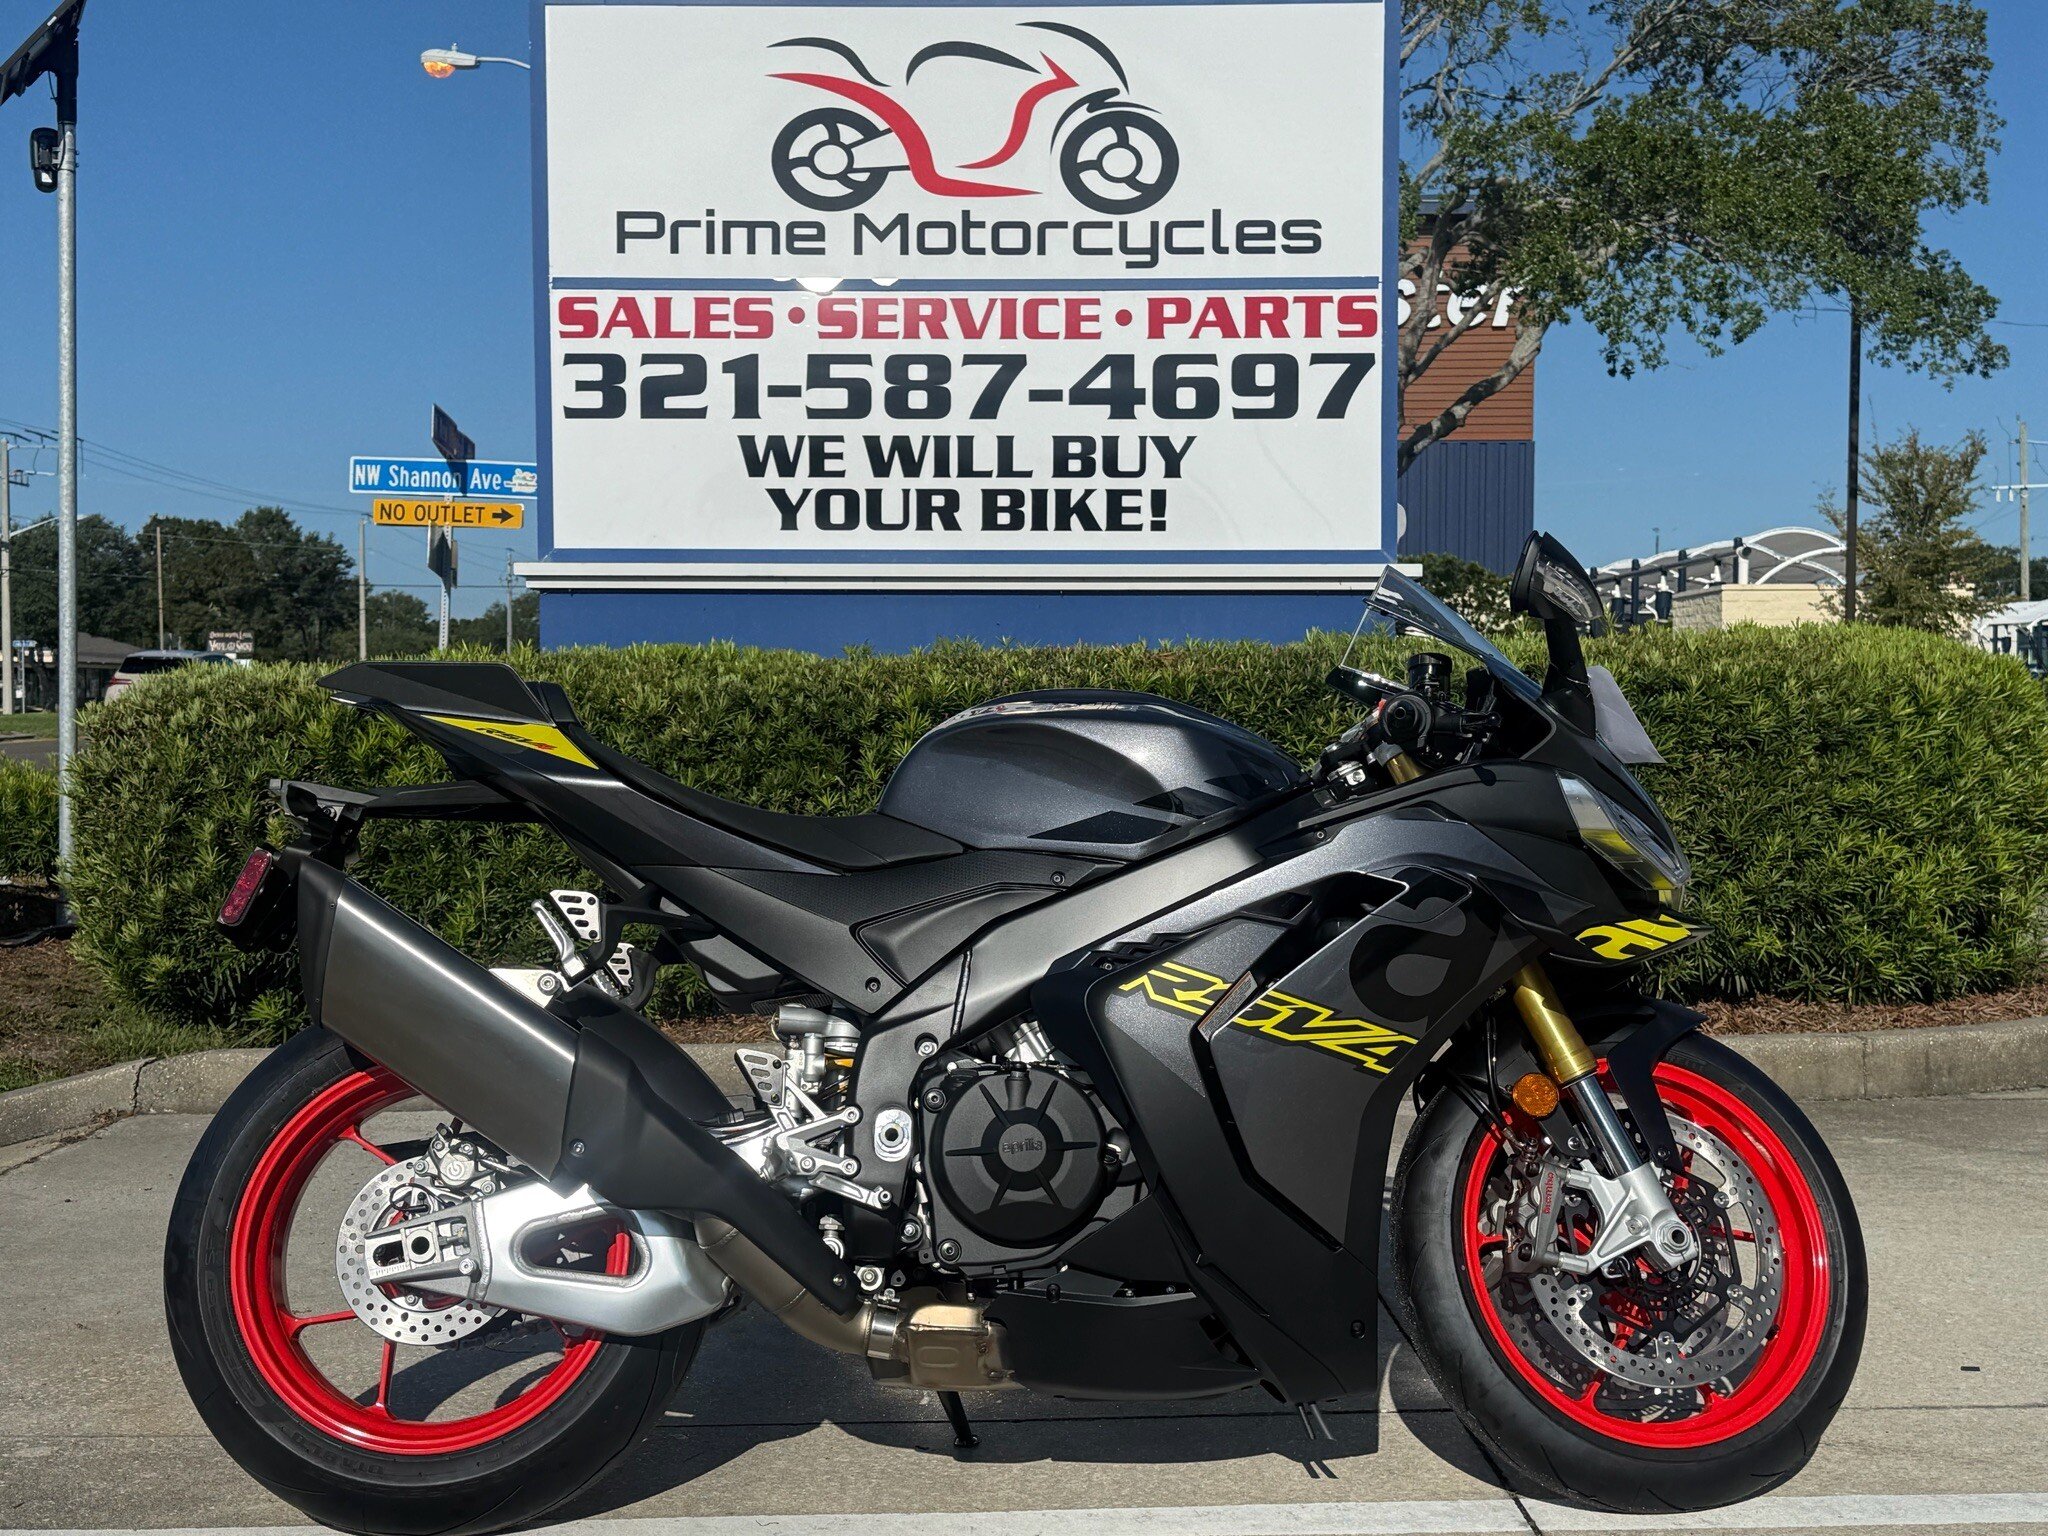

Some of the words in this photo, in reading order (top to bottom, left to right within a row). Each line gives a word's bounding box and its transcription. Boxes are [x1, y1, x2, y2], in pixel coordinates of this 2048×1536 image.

[616, 208, 827, 256] Prime
[853, 208, 1322, 269] Motorcycles
[558, 296, 774, 340] SALES
[817, 296, 1101, 340] SERVICE
[1147, 295, 1378, 339] PARTS
[562, 352, 1376, 420] 321-587-4697
[355, 464, 381, 486] NW
[388, 464, 462, 489] Shannon
[470, 468, 502, 490] Ave
[737, 435, 846, 478] WE
[863, 435, 1034, 479] WILL
[1051, 435, 1197, 479] BUY
[379, 503, 406, 521] NO
[414, 504, 486, 524] OUTLET
[765, 488, 962, 532] YOUR
[980, 488, 1167, 532] BIKE!
[1002, 1137, 1043, 1155] aprilia
